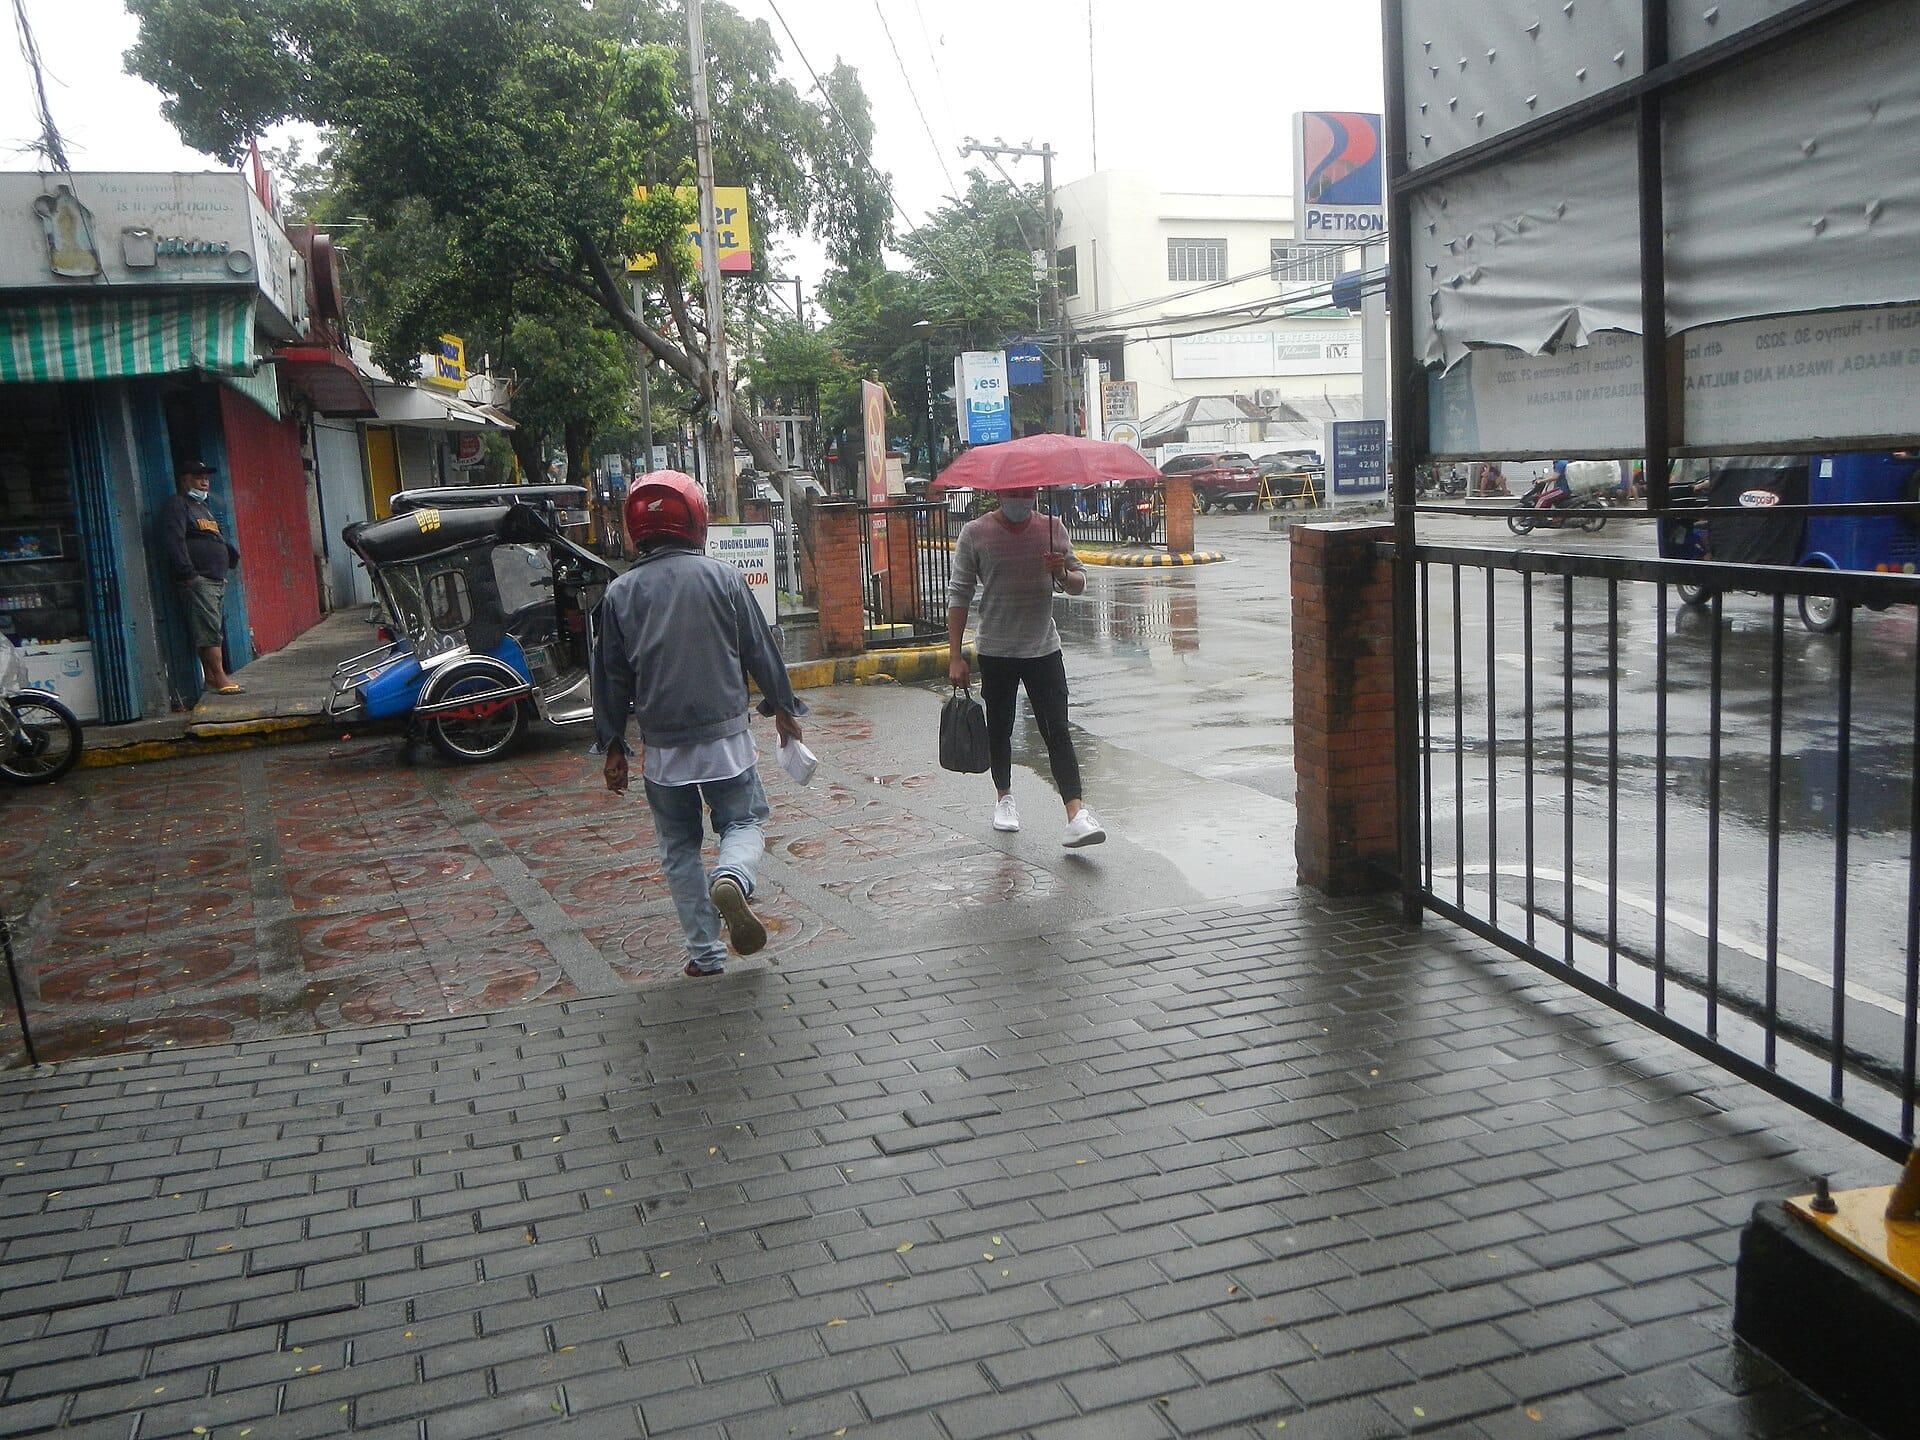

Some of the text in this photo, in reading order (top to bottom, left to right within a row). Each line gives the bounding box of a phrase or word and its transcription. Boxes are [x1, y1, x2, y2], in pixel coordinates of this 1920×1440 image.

[1307, 209, 1384, 231] PETRON
[1183, 332, 1268, 344] MANAID
[1278, 331, 1362, 344] ENTERPRISES
[926, 371, 934, 420] BALIUAG
[1358, 444, 1380, 452] 42.05
[743, 537, 769, 549] BALIWAG
